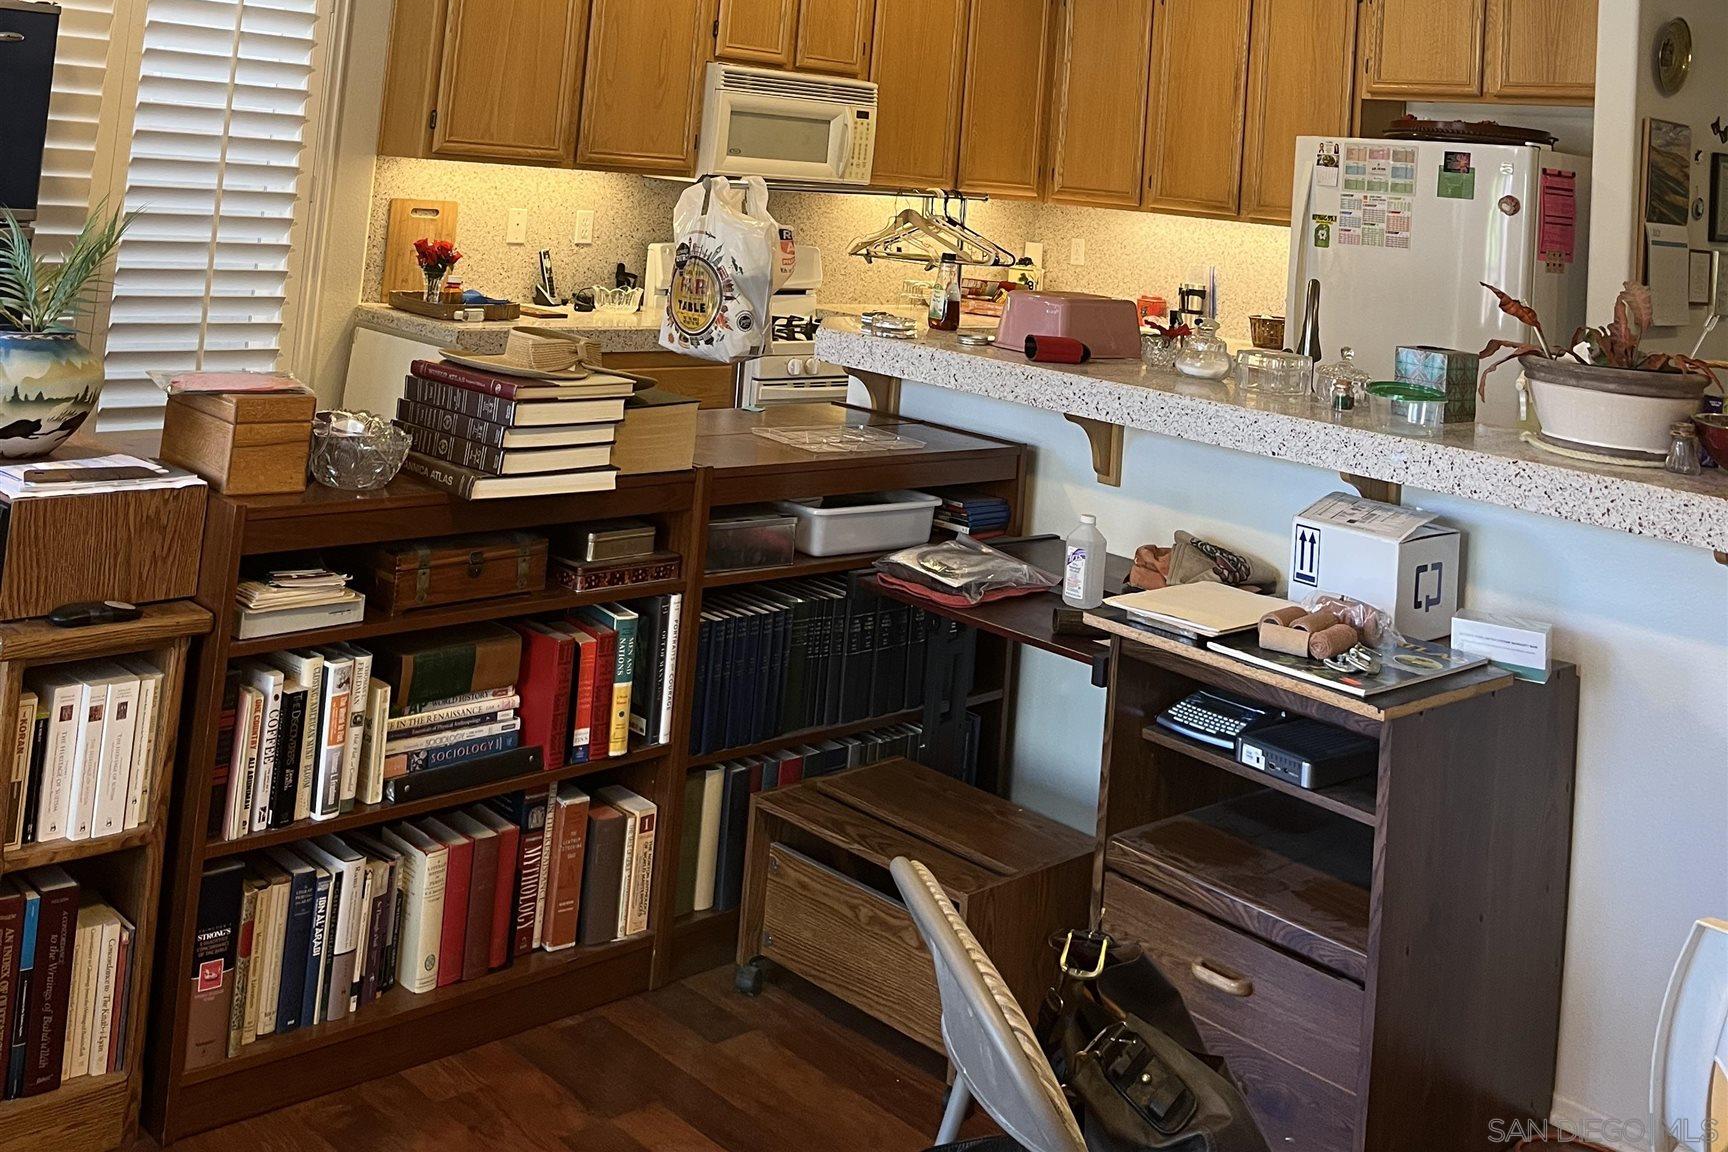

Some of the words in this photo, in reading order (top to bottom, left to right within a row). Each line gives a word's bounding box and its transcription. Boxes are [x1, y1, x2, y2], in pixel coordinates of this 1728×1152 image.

[678, 300, 706, 313] TABLE
[430, 469, 453, 486] ATLAS
[627, 636, 635, 656] MEN
[670, 619, 679, 661] PORTRAITS
[616, 637, 627, 676] NATIONS
[625, 658, 633, 675] AND
[353, 662, 364, 705] FRIEDMAN
[666, 673, 674, 712] COURAGE
[254, 699, 262, 714] ONE
[396, 719, 406, 728] IN
[407, 716, 425, 727] THE
[426, 705, 483, 723] RENAISSANCE
[250, 715, 260, 749] COUNTRY
[308, 701, 318, 739] AMERICAN
[17, 718, 28, 755] KORAN
[263, 709, 280, 765] COFFEE
[305, 740, 314, 759] MIND
[431, 739, 496, 763] SOCIOLOGY
[539, 835, 553, 902] RENAISSANCE
[517, 844, 543, 931] MYTHOLOGY
[318, 896, 327, 914] IBN
[5, 928, 15, 943] AN
[50, 934, 58, 944] to
[1, 946, 13, 979] INDEX
[49, 945, 59, 961] the
[105, 938, 116, 985] Concordance
[44, 962, 58, 1001] Writings
[43, 1002, 53, 1014] of
[102, 995, 112, 1008] The
